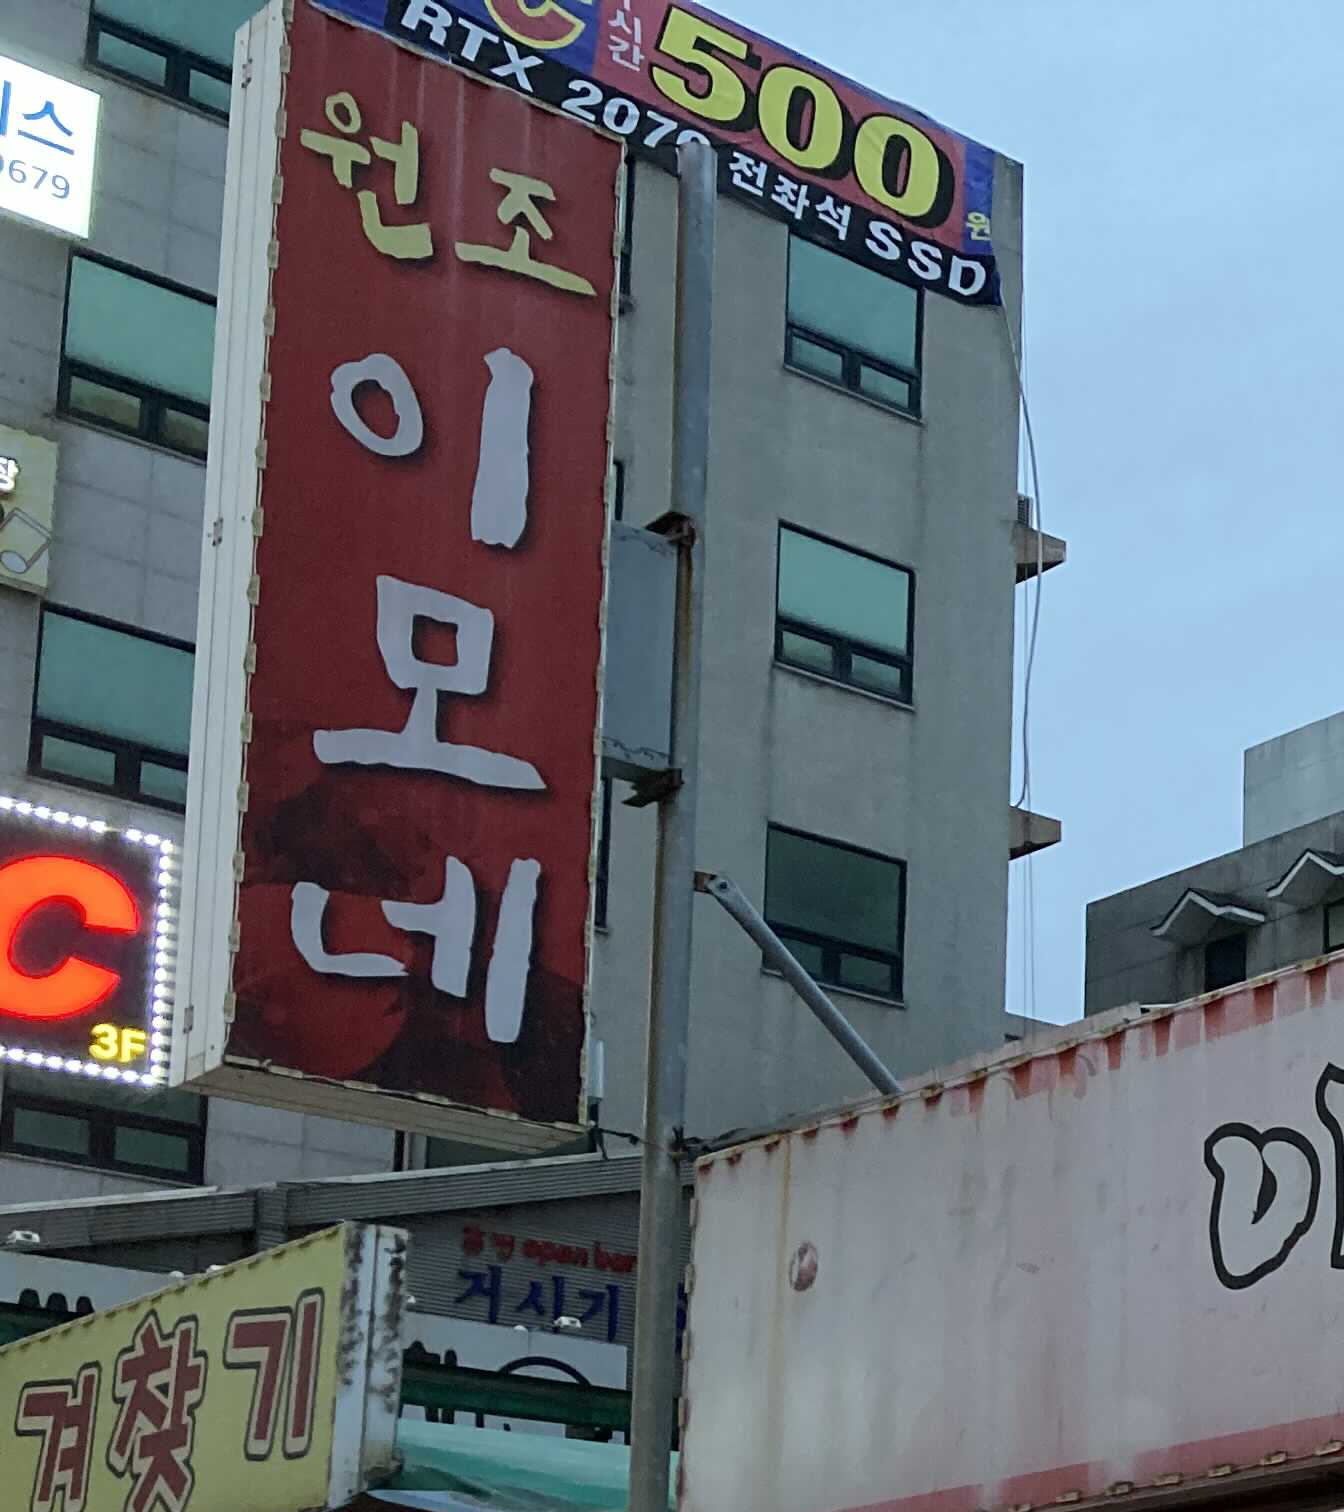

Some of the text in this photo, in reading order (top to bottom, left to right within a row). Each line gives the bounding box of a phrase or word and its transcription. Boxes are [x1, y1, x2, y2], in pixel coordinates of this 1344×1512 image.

[0, 79, 75, 155] 스
[300, 91, 596, 296] 원조
[400, 0, 540, 93] RTX
[727, 148, 852, 243] 전좌석
[864, 218, 987, 298] SSD
[650, 3, 945, 222] 500
[288, 347, 548, 1043] 이모네
[89, 1023, 148, 1063] 3F
